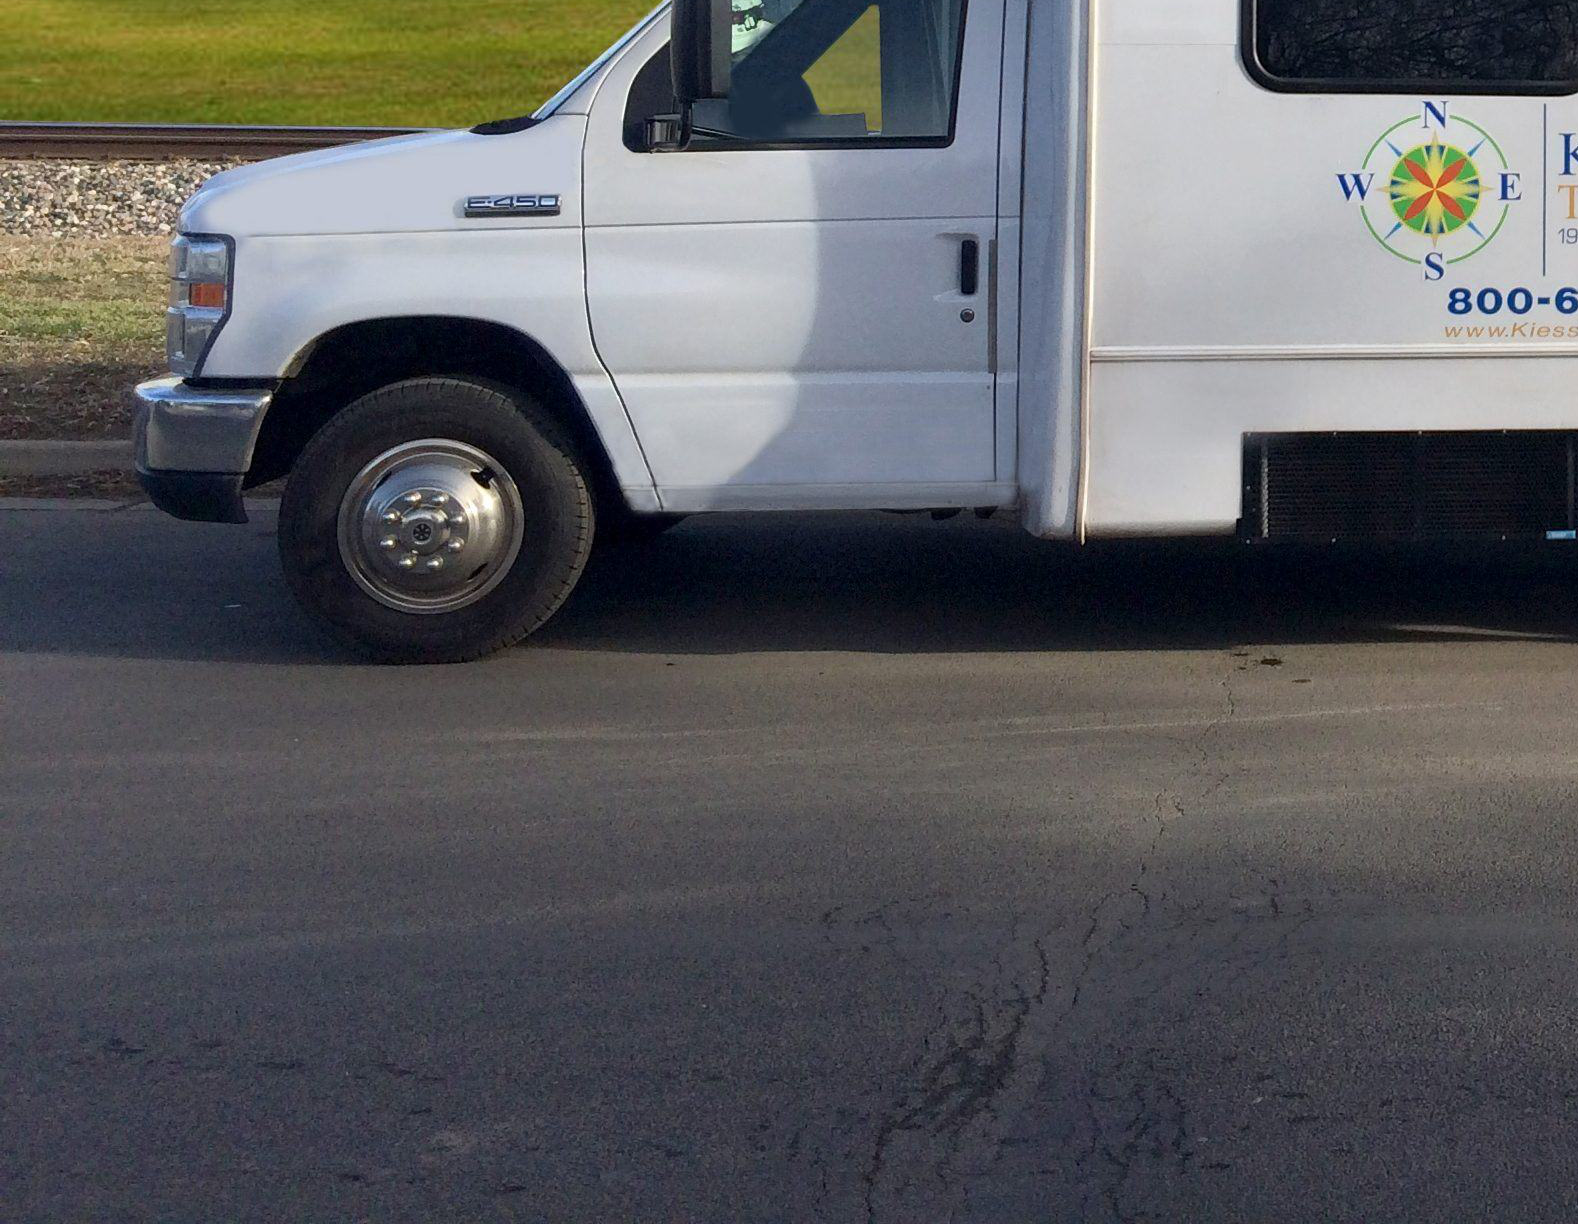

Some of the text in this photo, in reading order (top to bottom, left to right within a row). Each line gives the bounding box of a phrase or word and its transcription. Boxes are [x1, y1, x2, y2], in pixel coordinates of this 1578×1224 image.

[1421, 100, 1449, 129] N
[1335, 172, 1375, 201] W
[1498, 172, 1522, 201] E
[466, 194, 560, 209] E-450
[1424, 251, 1445, 281] S
